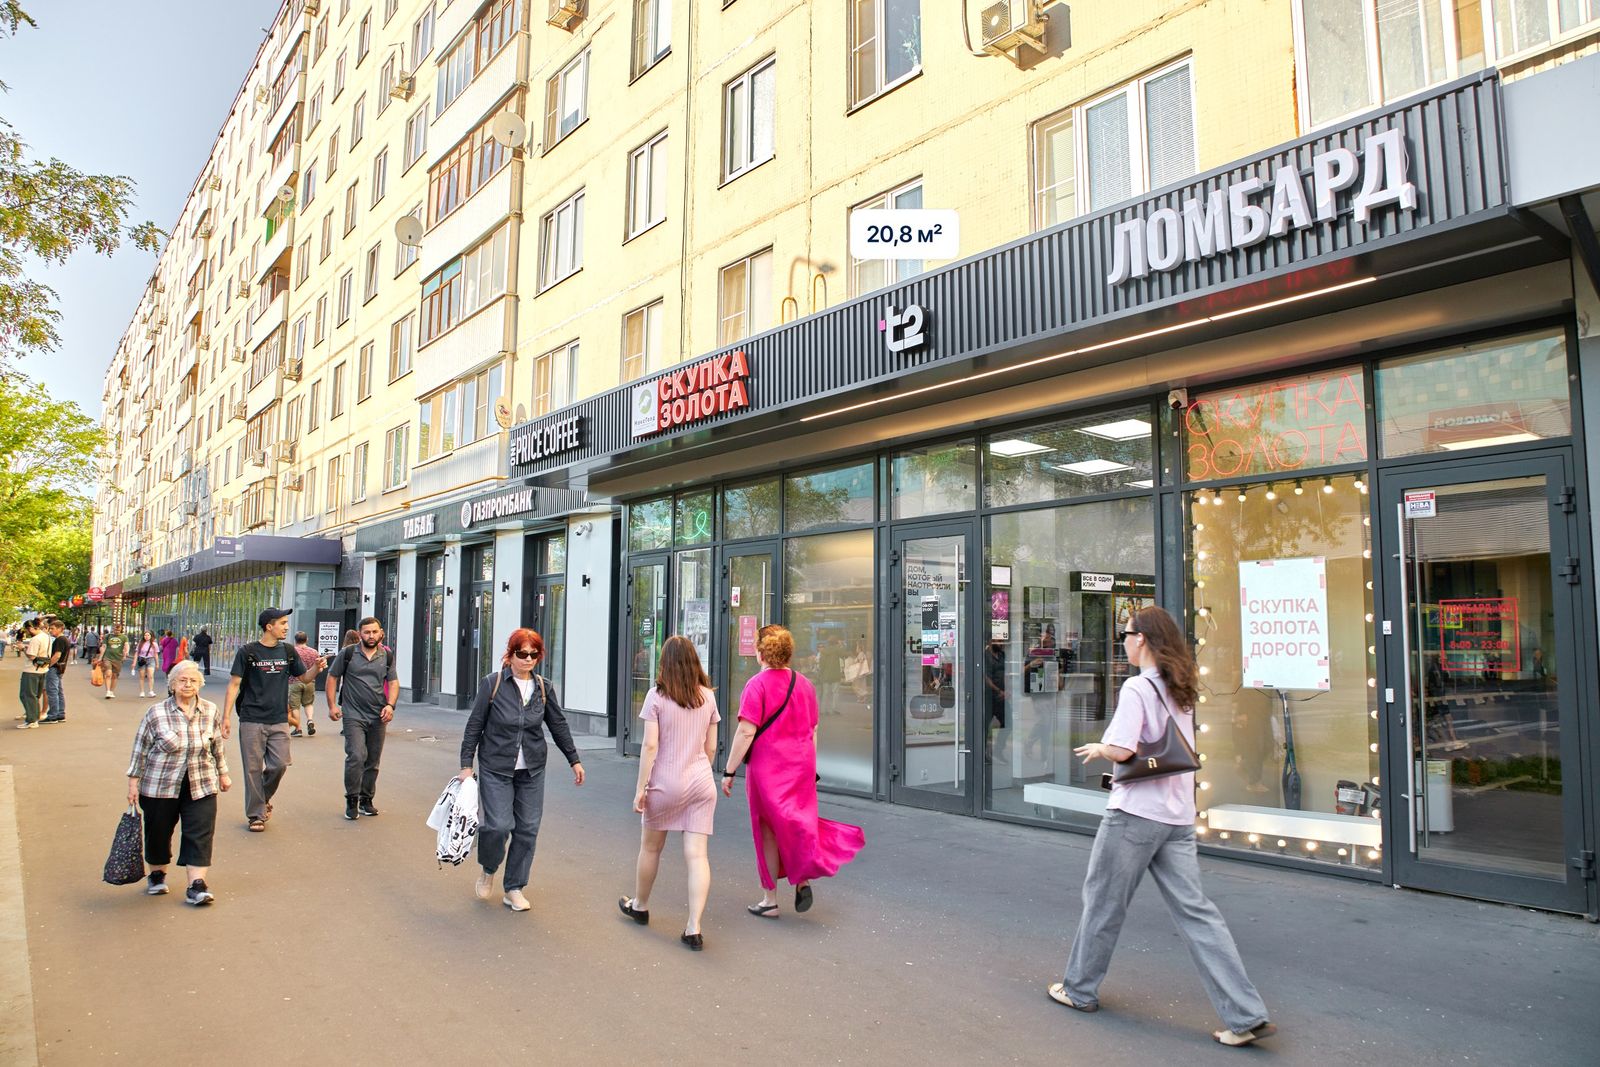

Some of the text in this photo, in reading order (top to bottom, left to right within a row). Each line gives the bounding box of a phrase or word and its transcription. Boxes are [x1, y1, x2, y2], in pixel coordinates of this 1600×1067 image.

[1107, 128, 1416, 286] ЛОМБАРД
[880, 304, 926, 352] t2
[660, 351, 748, 400] СКУПКА
[660, 380, 748, 428] ЗОЛОТА
[1185, 373, 1364, 436] СКУПКА
[516, 428, 543, 465] PRICE
[543, 415, 579, 456] COFFEE
[1187, 420, 1368, 480] ЗОЛОТА
[403, 513, 434, 539] ТАБАК
[472, 489, 533, 522] ГАЗПРОМБАНК
[1248, 598, 1319, 614] СКУПКА
[1249, 620, 1320, 635] ЗОЛОТА
[1250, 641, 1321, 659] ДОРОГО
